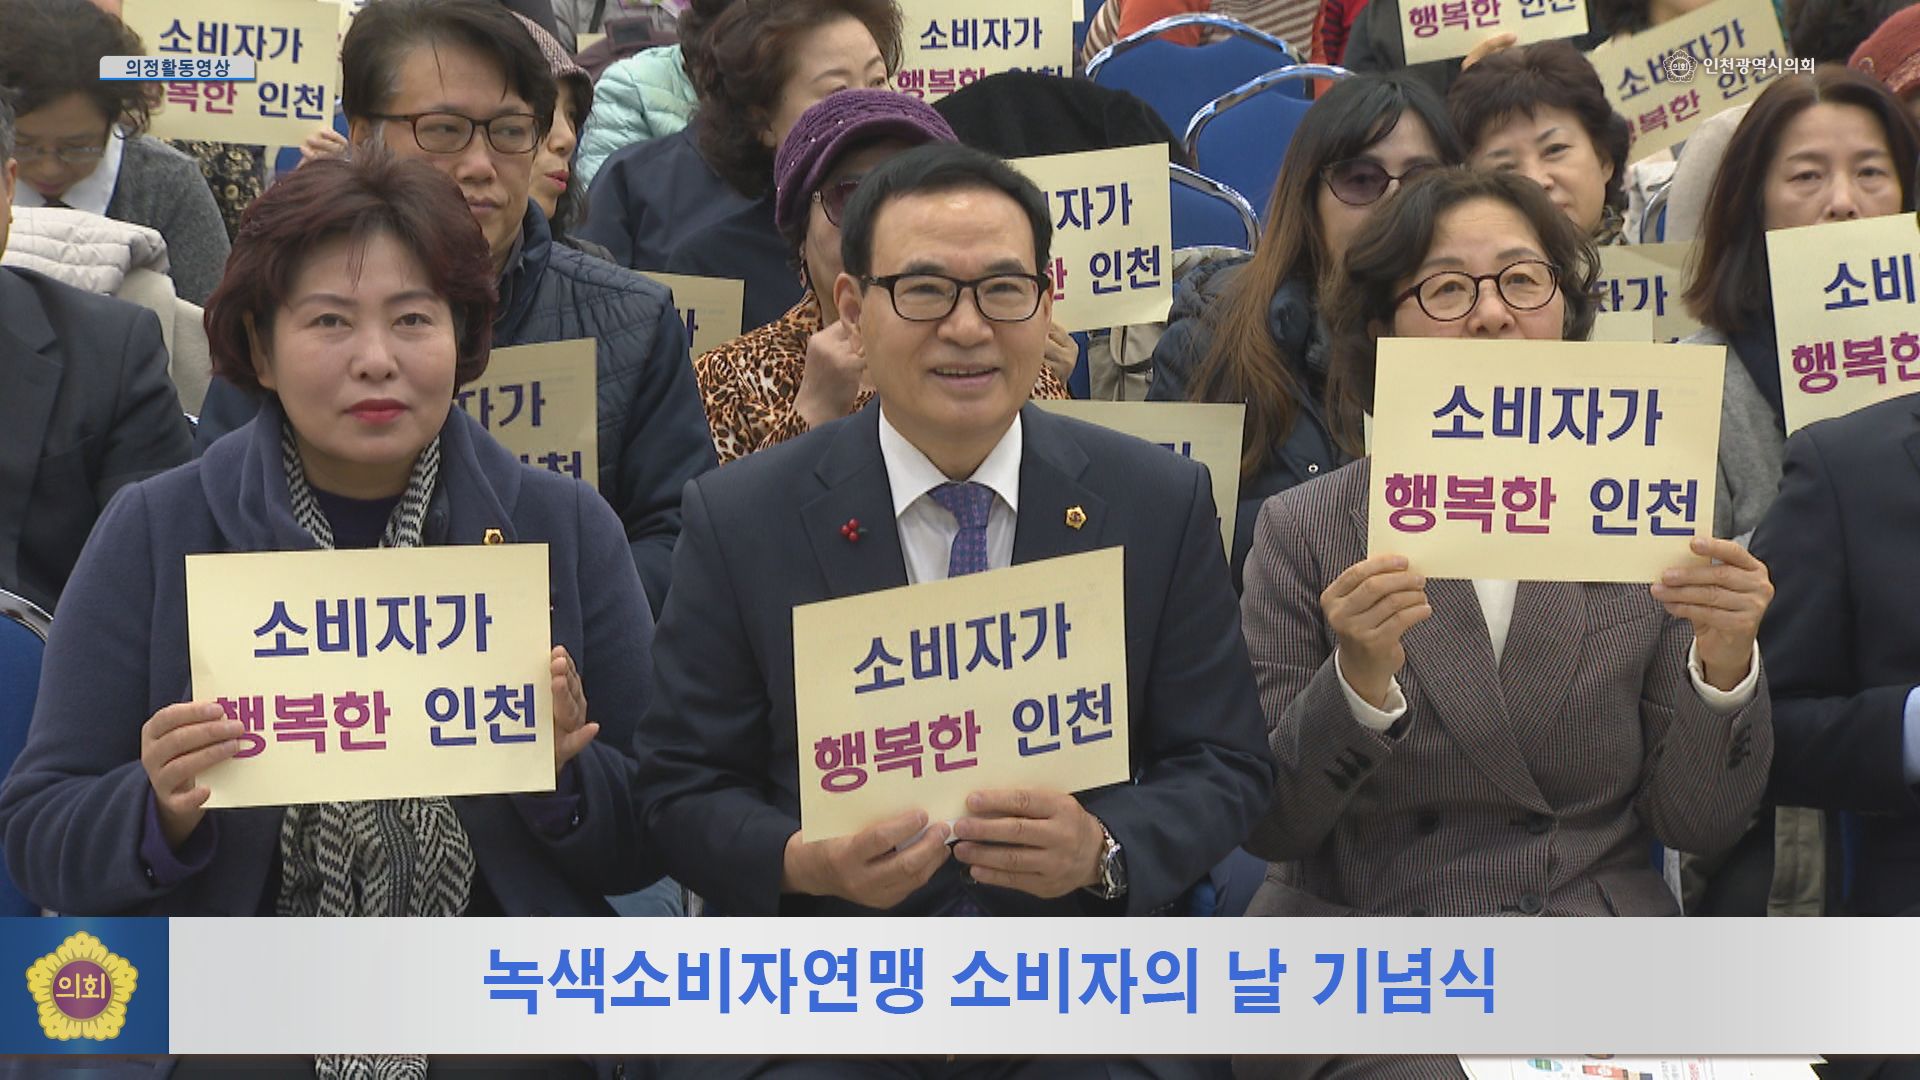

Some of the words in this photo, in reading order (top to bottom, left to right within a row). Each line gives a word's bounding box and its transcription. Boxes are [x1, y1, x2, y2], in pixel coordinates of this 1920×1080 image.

[159, 19, 303, 63] 소비자가
[920, 17, 1043, 50] 소비자가
[1409, 0, 1500, 37] 행복한
[148, 80, 237, 114] 복한
[258, 81, 325, 120] 인천
[1089, 245, 1160, 295] 인천
[1432, 385, 1662, 446] 소비자가
[1384, 473, 1556, 534] 행복한
[1589, 478, 1698, 536] 인천
[253, 594, 492, 658] 소비자가
[853, 602, 1071, 695] 소비자가
[424, 684, 537, 746] 인천
[814, 709, 981, 793] 행복한
[1012, 683, 1113, 757] 인천
